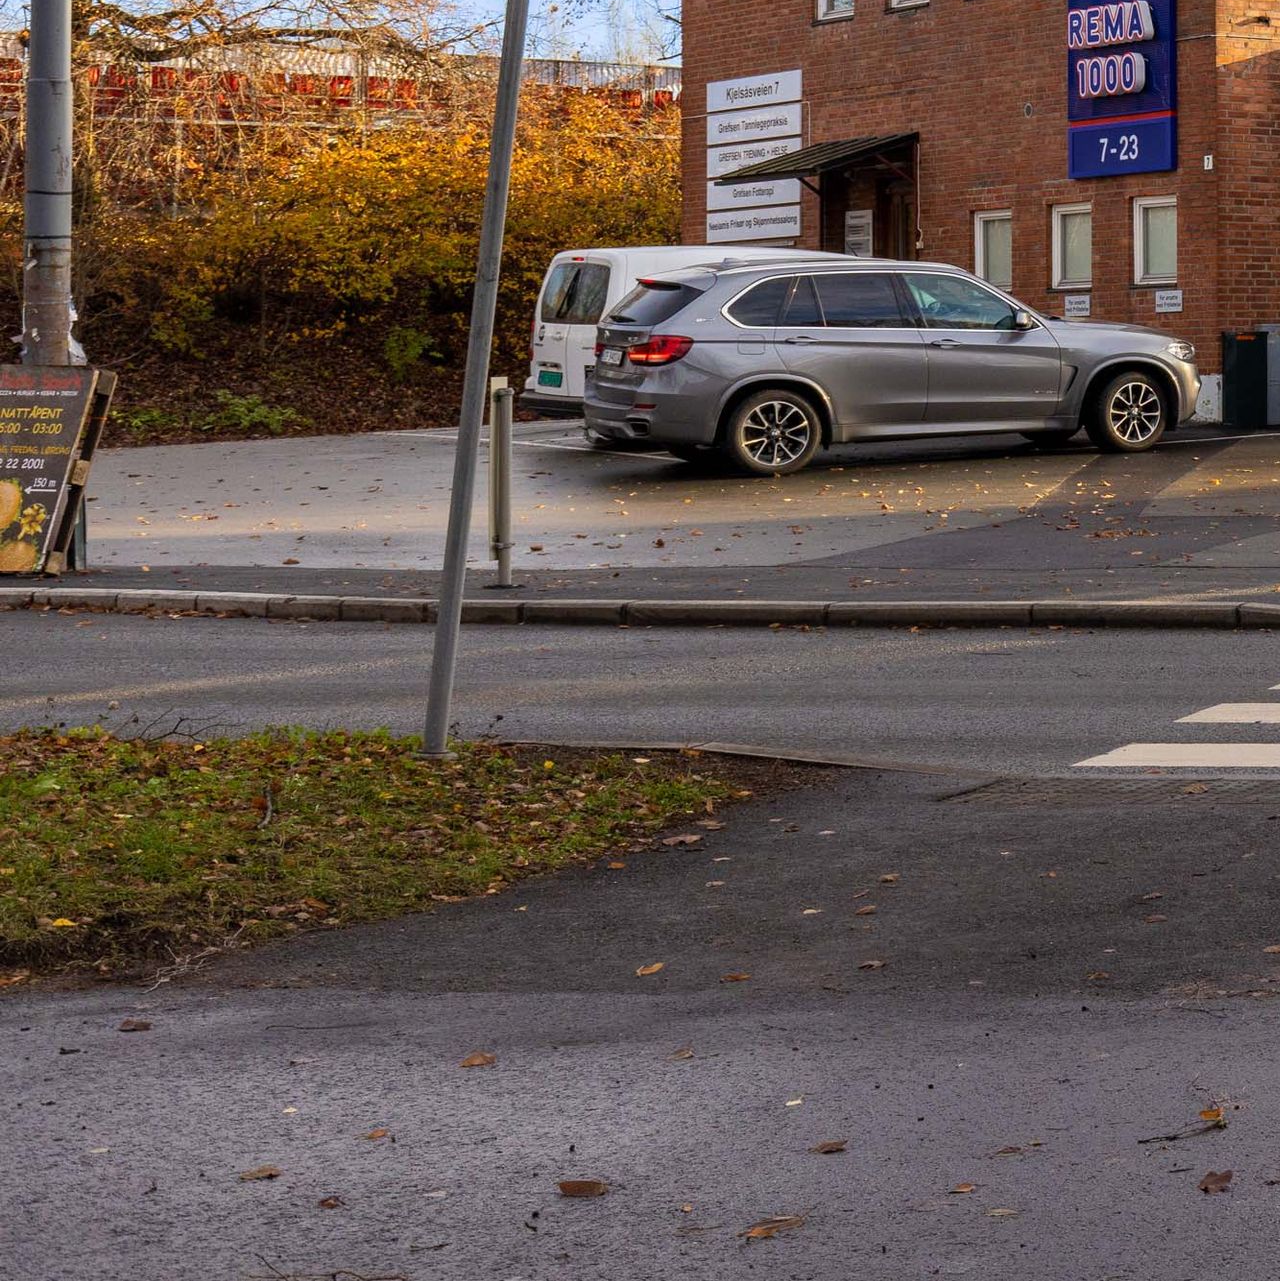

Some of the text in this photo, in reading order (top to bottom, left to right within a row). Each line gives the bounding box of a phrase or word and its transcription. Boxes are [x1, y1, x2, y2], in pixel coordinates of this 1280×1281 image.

[1067, 0, 1147, 49] REMA
[1075, 52, 1140, 99] 1000
[774, 81, 779, 94] 7
[1, 405, 64, 419] NATTÅPENT
[32, 422, 63, 434] 03:00
[5, 458, 19, 469] 22
[21, 458, 45, 469] 2001
[33, 477, 48, 488] 150
